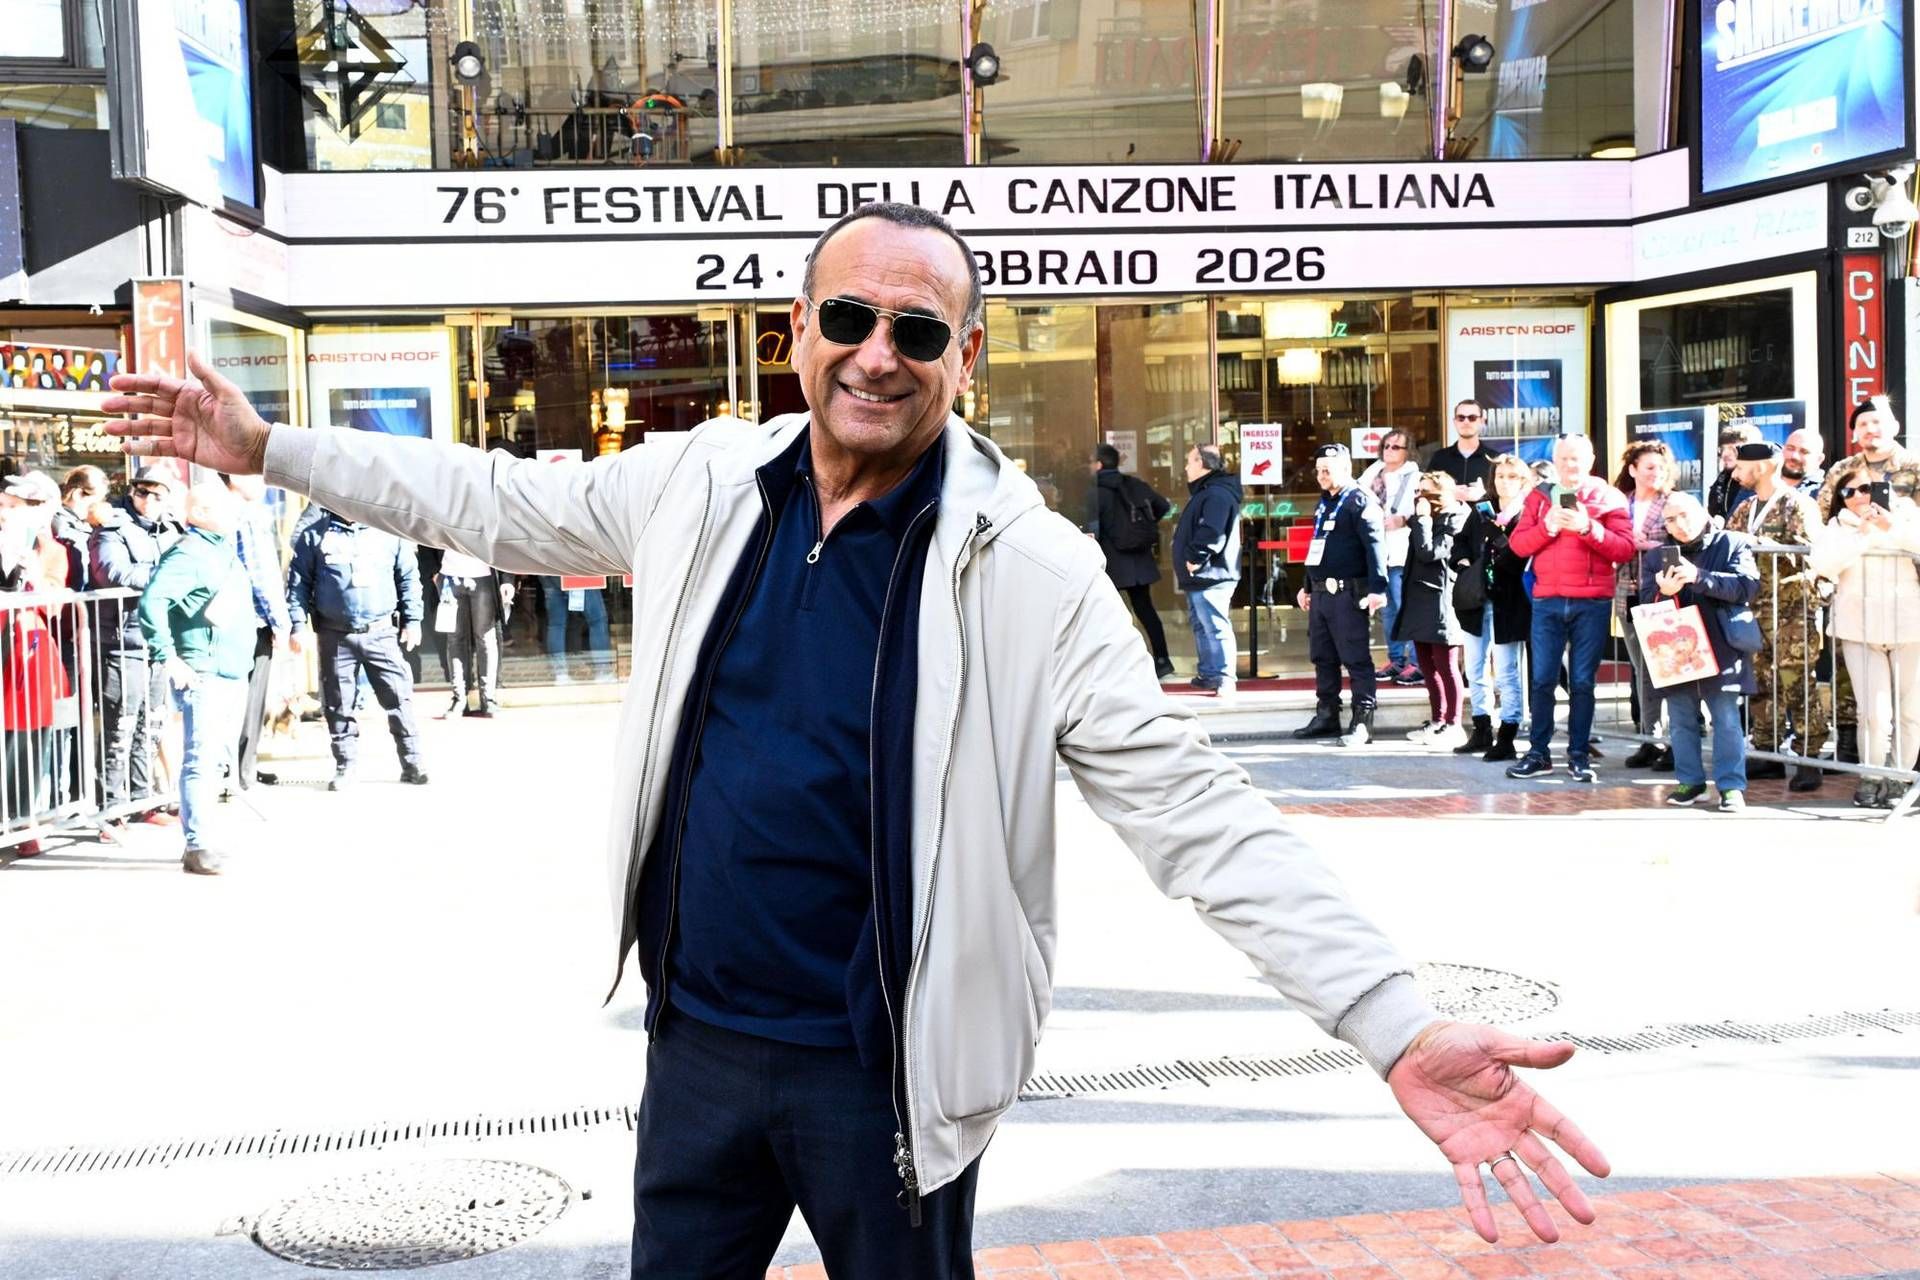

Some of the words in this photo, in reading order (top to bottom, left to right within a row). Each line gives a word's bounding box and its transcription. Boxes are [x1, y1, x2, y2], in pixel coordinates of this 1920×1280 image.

[544, 185, 782, 224] FESTIVAL
[1009, 175, 1236, 214] CANZONE
[1275, 173, 1494, 210] ITALIANA
[1854, 232, 1873, 244] 212
[978, 249, 1157, 286] BBRAIO
[1196, 247, 1325, 284] 2026
[1460, 325, 1529, 336] ARISTON
[1533, 324, 1576, 335] ROOF
[1849, 271, 1876, 407] CINE
[308, 352, 387, 363] ARISTON
[392, 351, 441, 361] ROOF
[1243, 429, 1279, 438] INGRESSO
[1250, 441, 1273, 450] PASS
